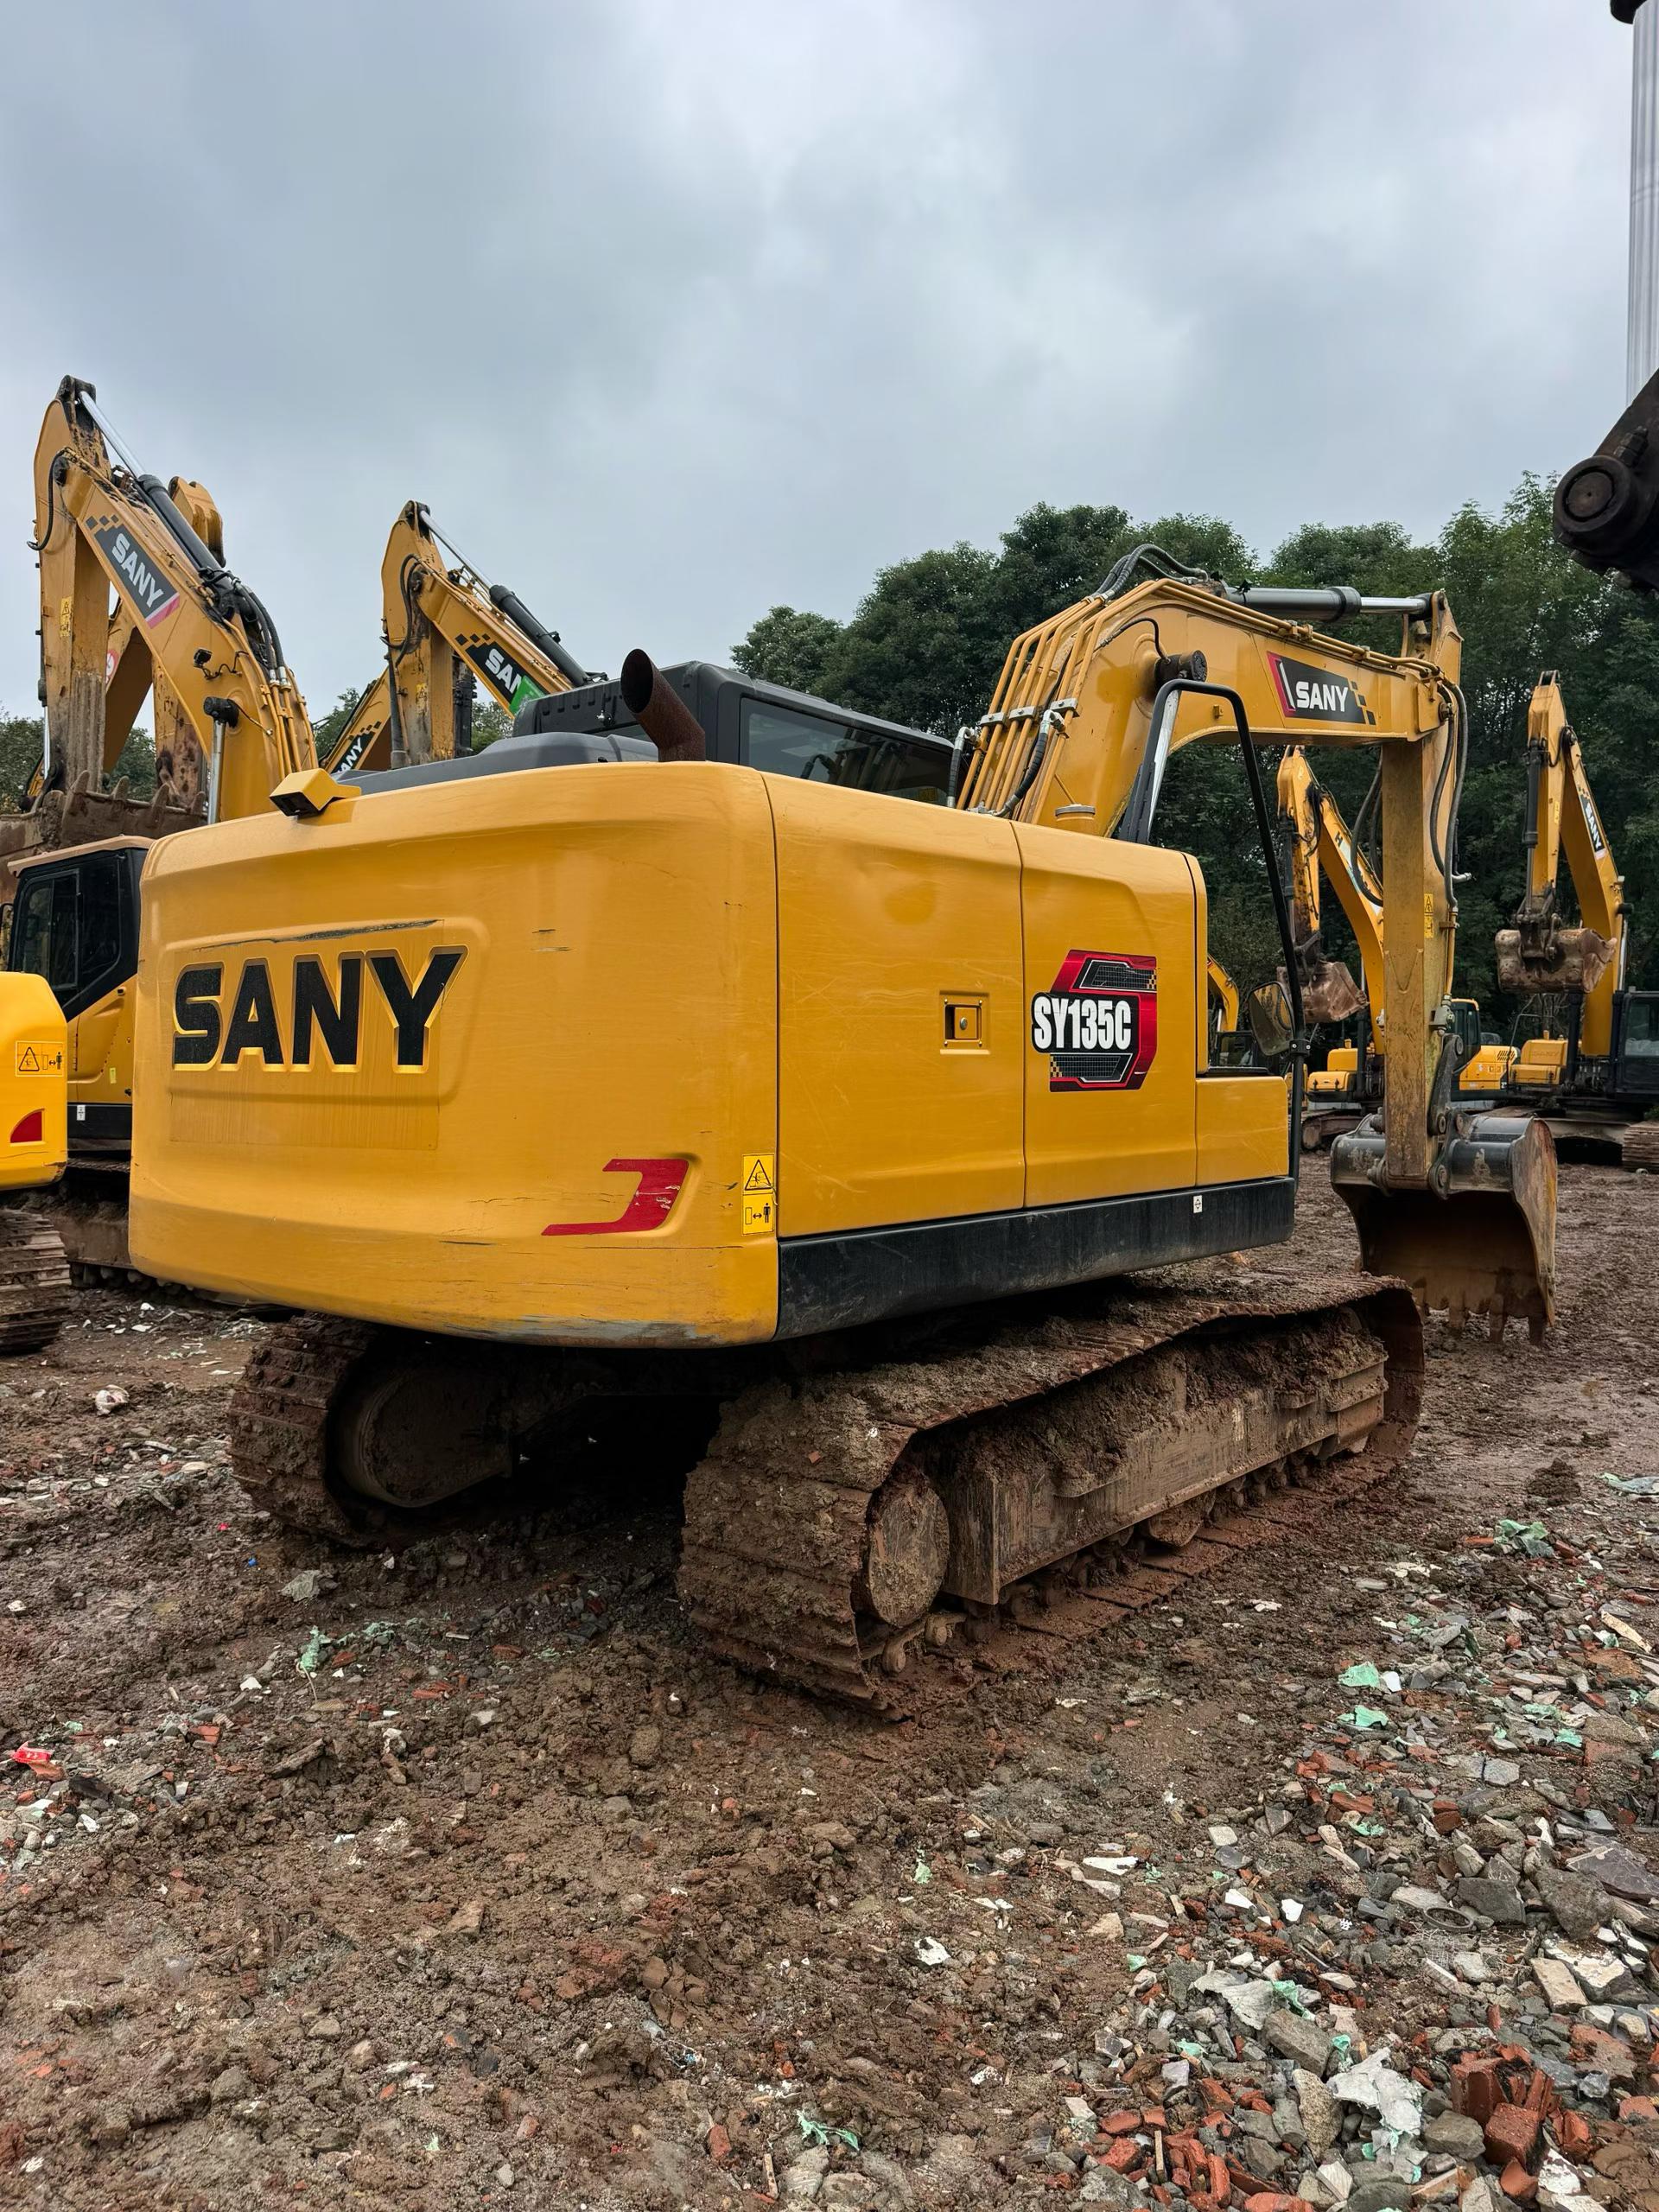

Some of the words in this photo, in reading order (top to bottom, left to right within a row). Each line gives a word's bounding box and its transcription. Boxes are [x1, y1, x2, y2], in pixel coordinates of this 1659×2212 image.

[111, 533, 164, 608] SANY
[1296, 681, 1349, 712] SANY
[339, 737, 363, 774] ANY
[1585, 802, 1602, 849] SANY
[173, 948, 466, 1071] SANY
[1033, 995, 1132, 1050] SY135C
